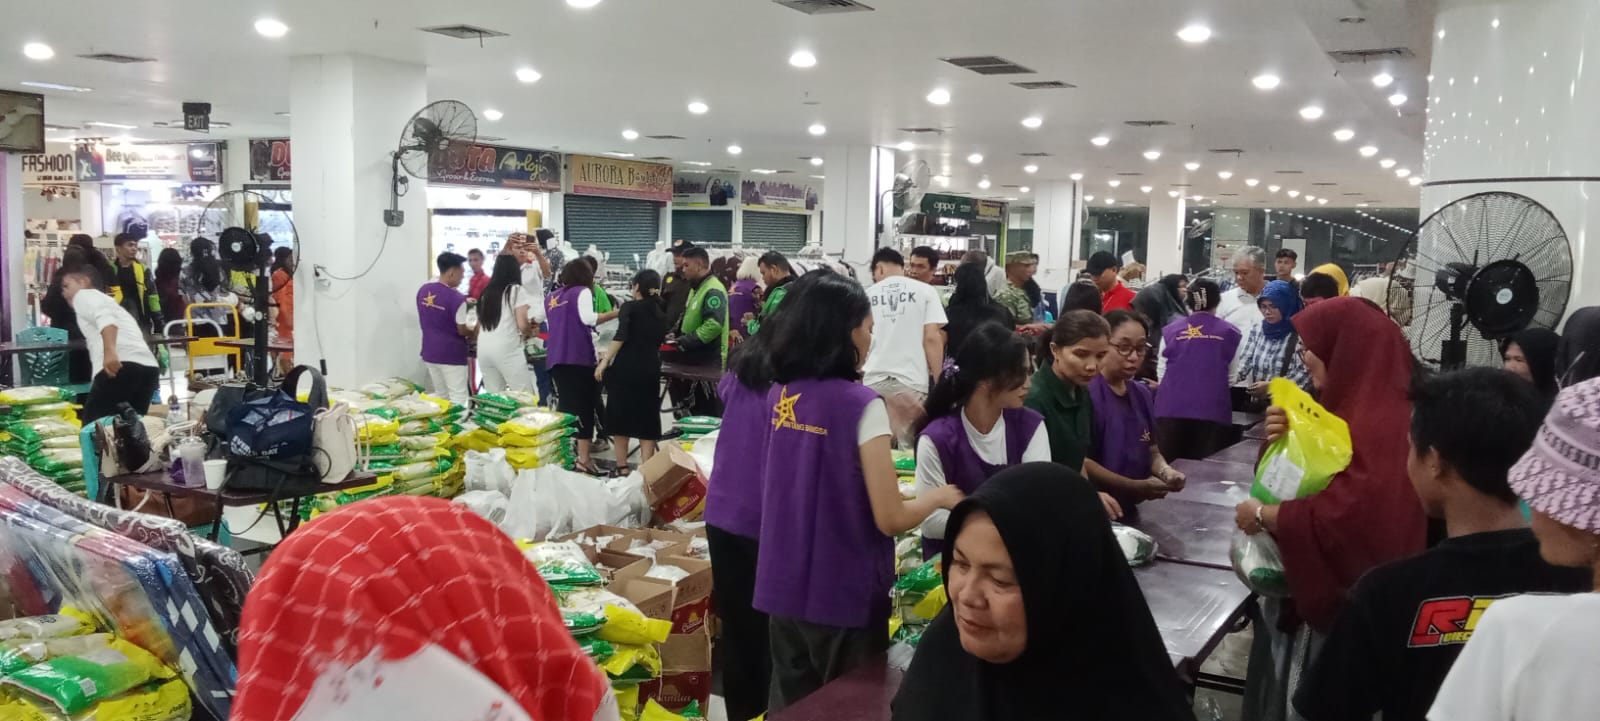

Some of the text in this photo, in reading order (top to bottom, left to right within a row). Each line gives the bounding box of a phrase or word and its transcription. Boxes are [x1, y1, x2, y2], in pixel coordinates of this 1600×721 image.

[188, 115, 205, 128] EXIT
[21, 154, 73, 172] FASHION
[500, 152, 545, 181] Arloji
[580, 162, 625, 185] AURORA
[871, 291, 917, 307] BLCK
